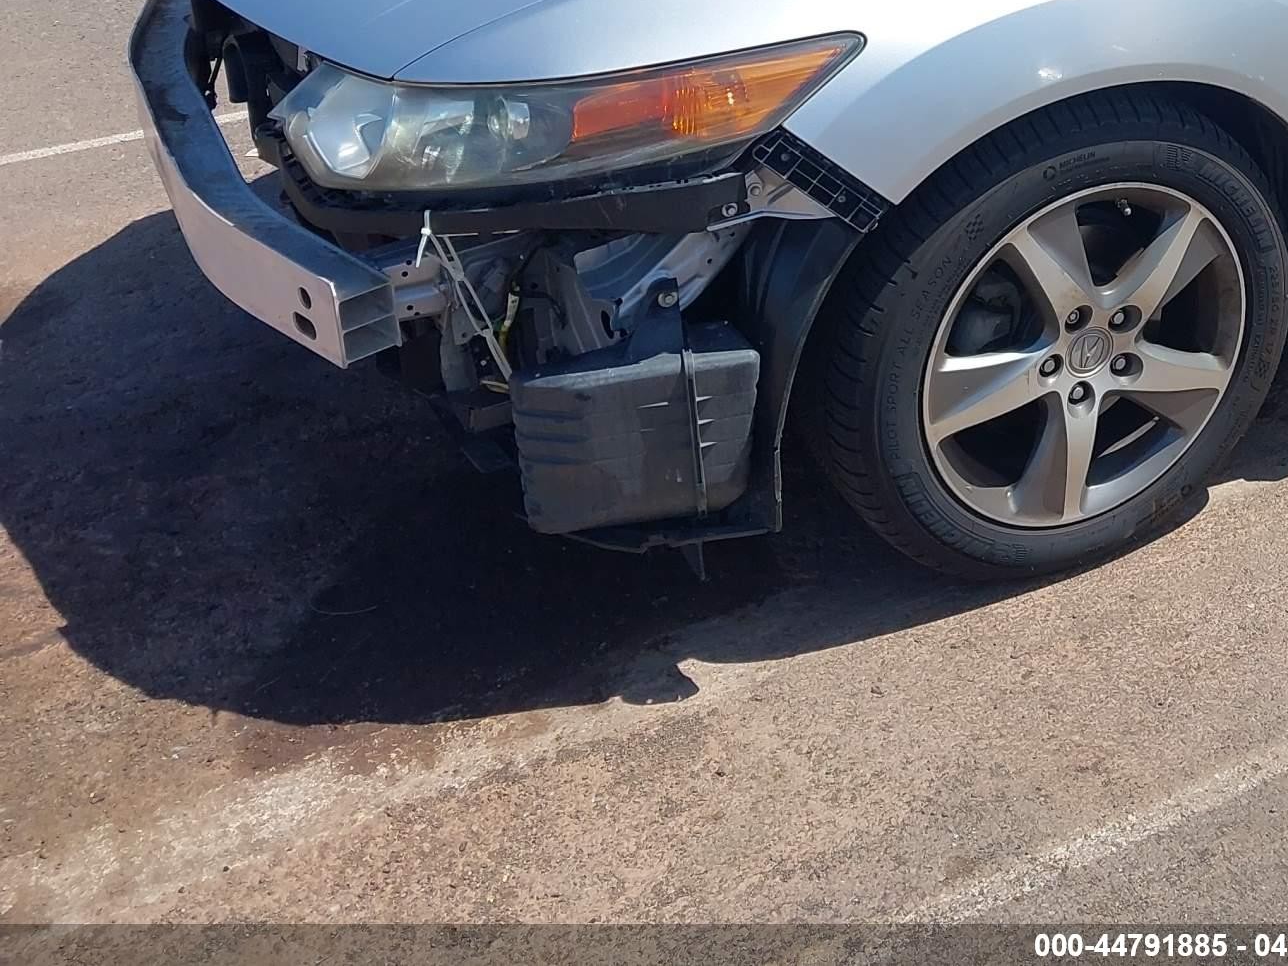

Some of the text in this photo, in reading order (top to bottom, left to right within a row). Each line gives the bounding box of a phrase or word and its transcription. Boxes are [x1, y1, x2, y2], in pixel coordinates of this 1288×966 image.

[1196, 161, 1274, 254] MICHELIN
[886, 257, 952, 460] PILOT SPORT ALL SEASON
